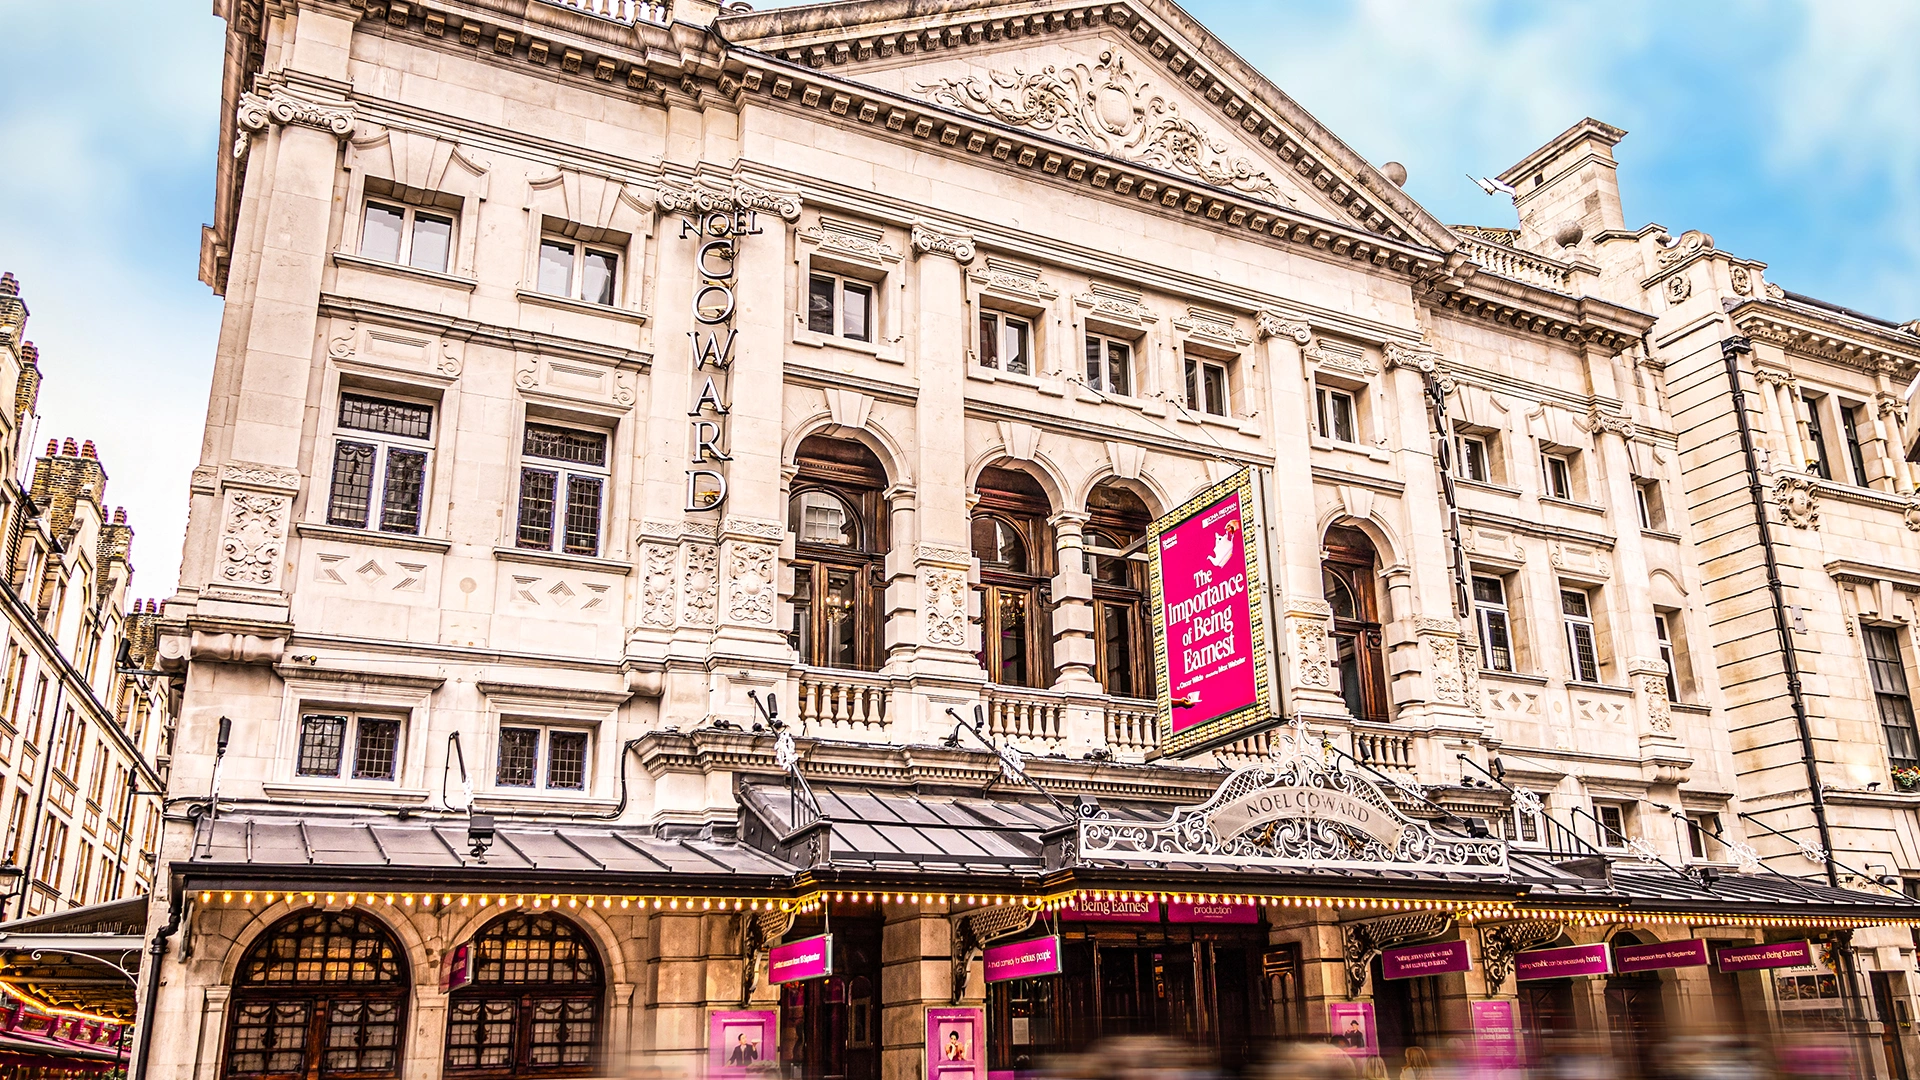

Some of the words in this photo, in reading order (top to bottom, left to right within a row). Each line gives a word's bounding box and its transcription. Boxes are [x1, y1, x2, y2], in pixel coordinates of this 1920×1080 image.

[679, 207, 764, 239] NOËL
[684, 239, 739, 513] COWARD
[1193, 569, 1213, 588] The
[1167, 573, 1244, 626] Importance
[1182, 627, 1192, 646] of
[1193, 605, 1234, 641] Being
[1183, 631, 1235, 674] Earnest
[1296, 791, 1369, 823] COWARD
[1081, 900, 1110, 915] Being
[1112, 899, 1149, 913] Earnest
[1020, 953, 1036, 963] serious
[1036, 949, 1052, 963] people
[1585, 955, 1602, 963] boring
[1624, 955, 1639, 963] Limited
[1671, 950, 1696, 958] September
[1731, 953, 1761, 963] Importance
[1766, 950, 1782, 960] Being
[1782, 949, 1803, 958] Earnest
